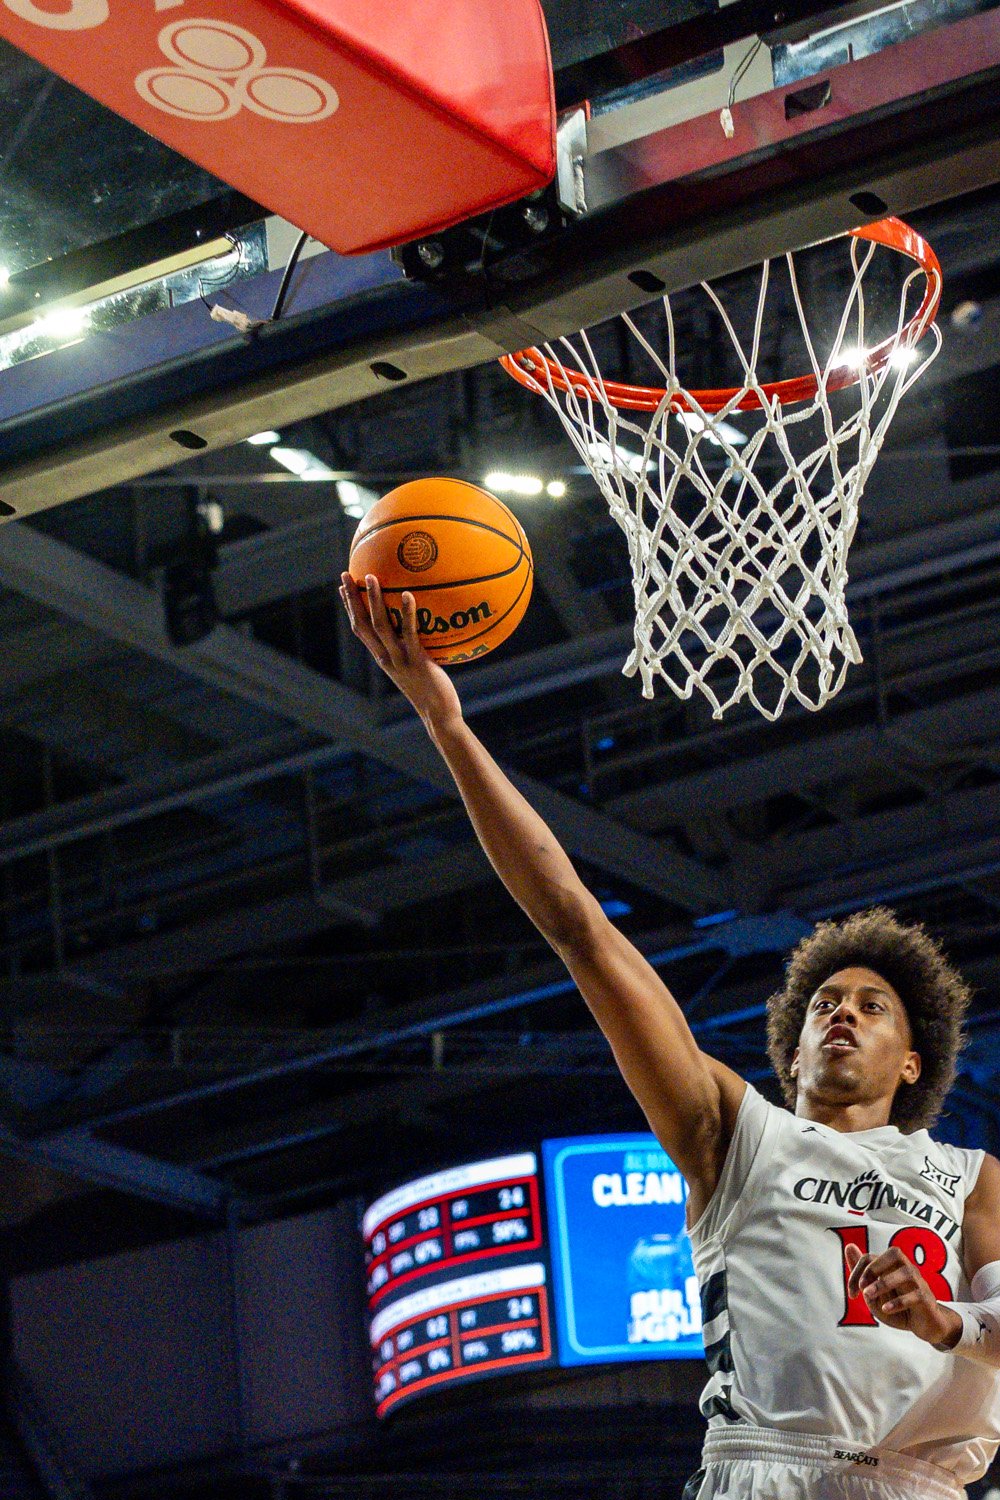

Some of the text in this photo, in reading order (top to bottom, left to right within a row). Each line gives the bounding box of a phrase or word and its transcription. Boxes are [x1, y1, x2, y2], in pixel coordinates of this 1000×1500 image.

[387, 602, 491, 636] lson
[592, 1173, 683, 1207] CLEAN
[793, 1171, 960, 1242] CINCINNATI
[828, 1225, 954, 1328] 18
[833, 1449, 879, 1467] BEARCATS
